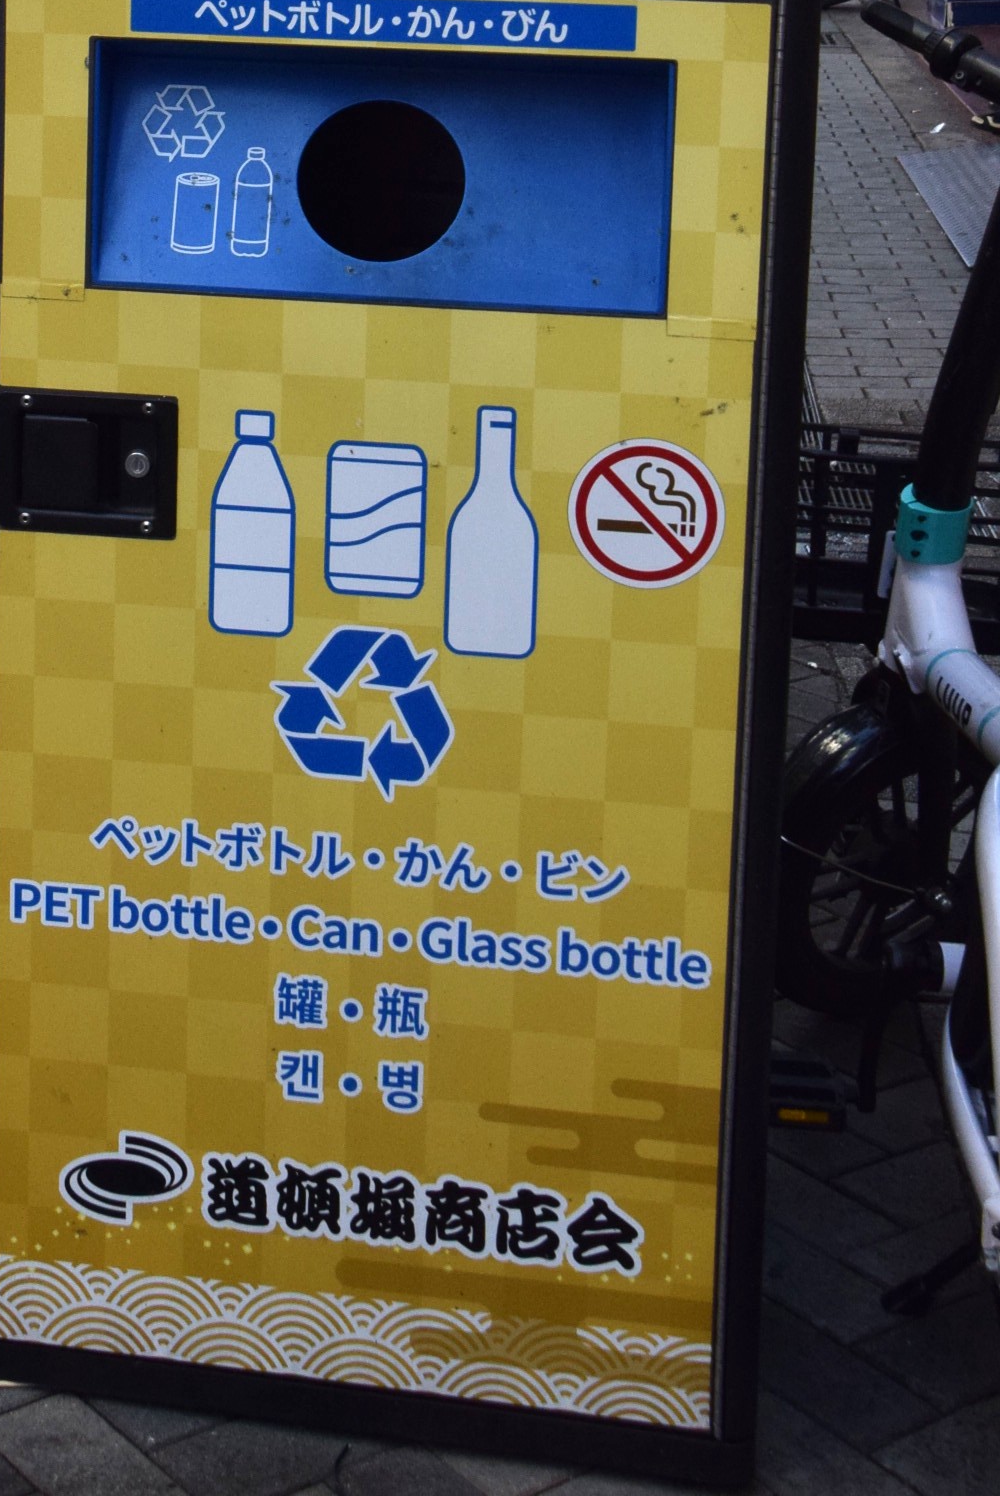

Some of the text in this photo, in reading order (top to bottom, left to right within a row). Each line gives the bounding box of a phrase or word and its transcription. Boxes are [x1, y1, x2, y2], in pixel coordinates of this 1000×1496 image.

[92, 815, 629, 902] ペットボトル・かん・ビン
[11, 883, 99, 926] PET
[559, 931, 710, 986] bottle
[207, 1154, 640, 1272] 道頓堀商店会
